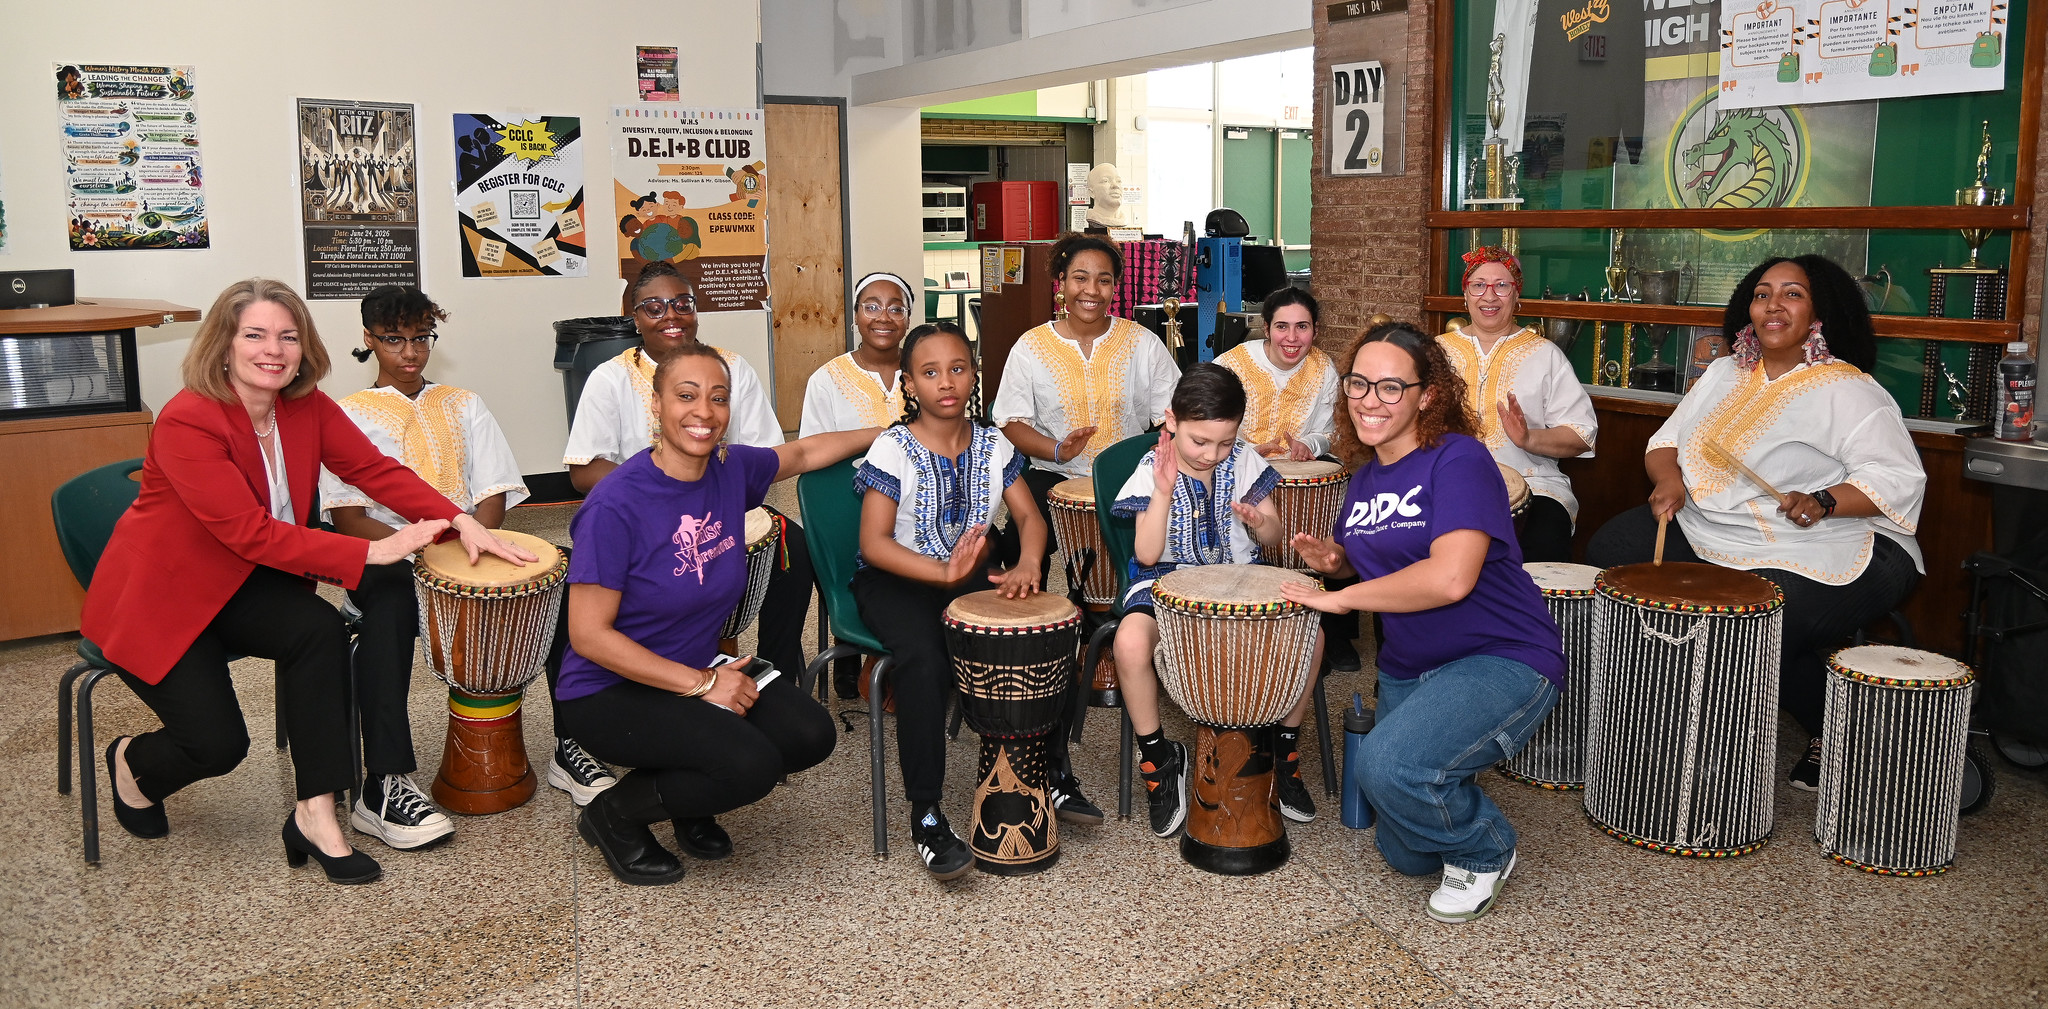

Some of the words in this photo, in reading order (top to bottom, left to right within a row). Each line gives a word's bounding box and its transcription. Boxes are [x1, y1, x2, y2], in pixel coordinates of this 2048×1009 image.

[1346, 4, 1360, 16] THIS
[1830, 11, 1877, 24] IMPORTANTE
[1744, 19, 1782, 30] IMPORTANT
[99, 88, 135, 97] Sustainable
[1335, 67, 1381, 106] DAY
[1285, 106, 1299, 120] EXIT
[509, 129, 533, 141] CCLC
[1344, 109, 1370, 169] 2
[529, 143, 547, 151] BACK!
[628, 138, 700, 158] D.E.I+B
[705, 139, 750, 158] CLUB
[478, 173, 520, 194] REGISTER
[523, 173, 540, 186] FOR
[542, 176, 565, 194] CCLC
[1391, 520, 1426, 529] Company
